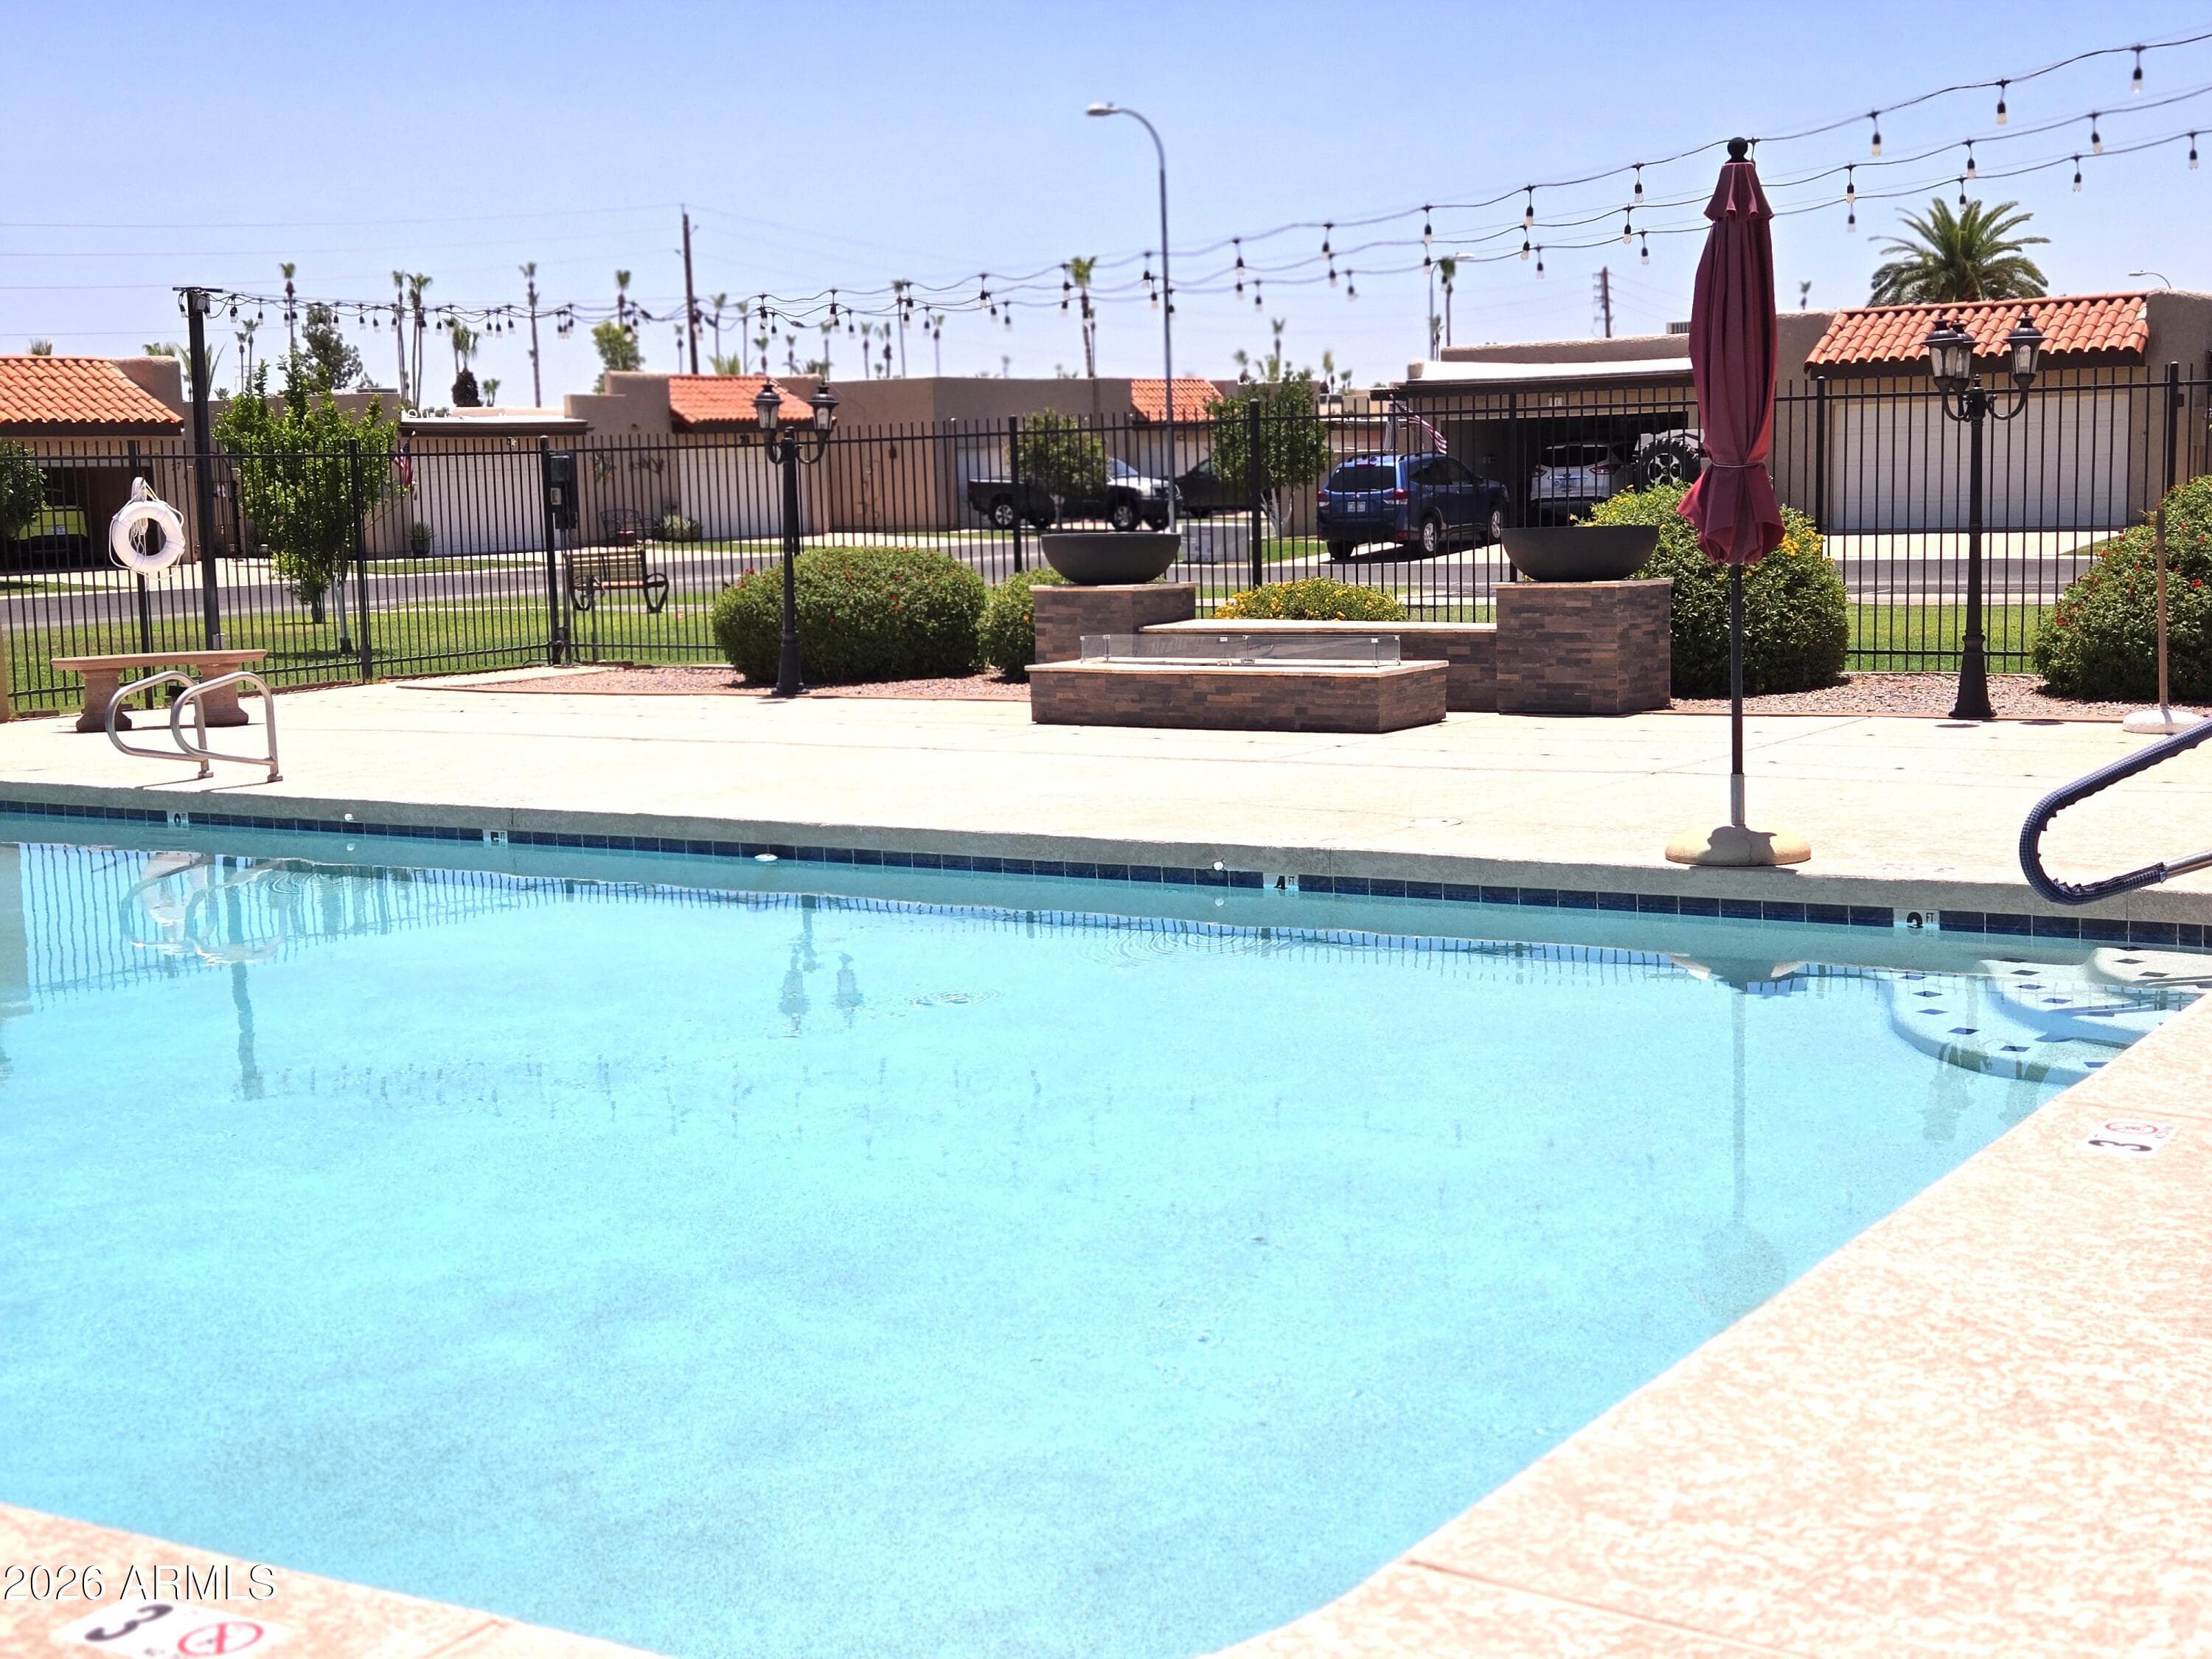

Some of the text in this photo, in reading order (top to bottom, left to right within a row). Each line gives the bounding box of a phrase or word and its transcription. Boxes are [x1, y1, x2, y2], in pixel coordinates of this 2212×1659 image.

[1926, 912, 1935, 923] FT
[2088, 1139, 2153, 1152] 3
[84, 1604, 174, 1642] 3
